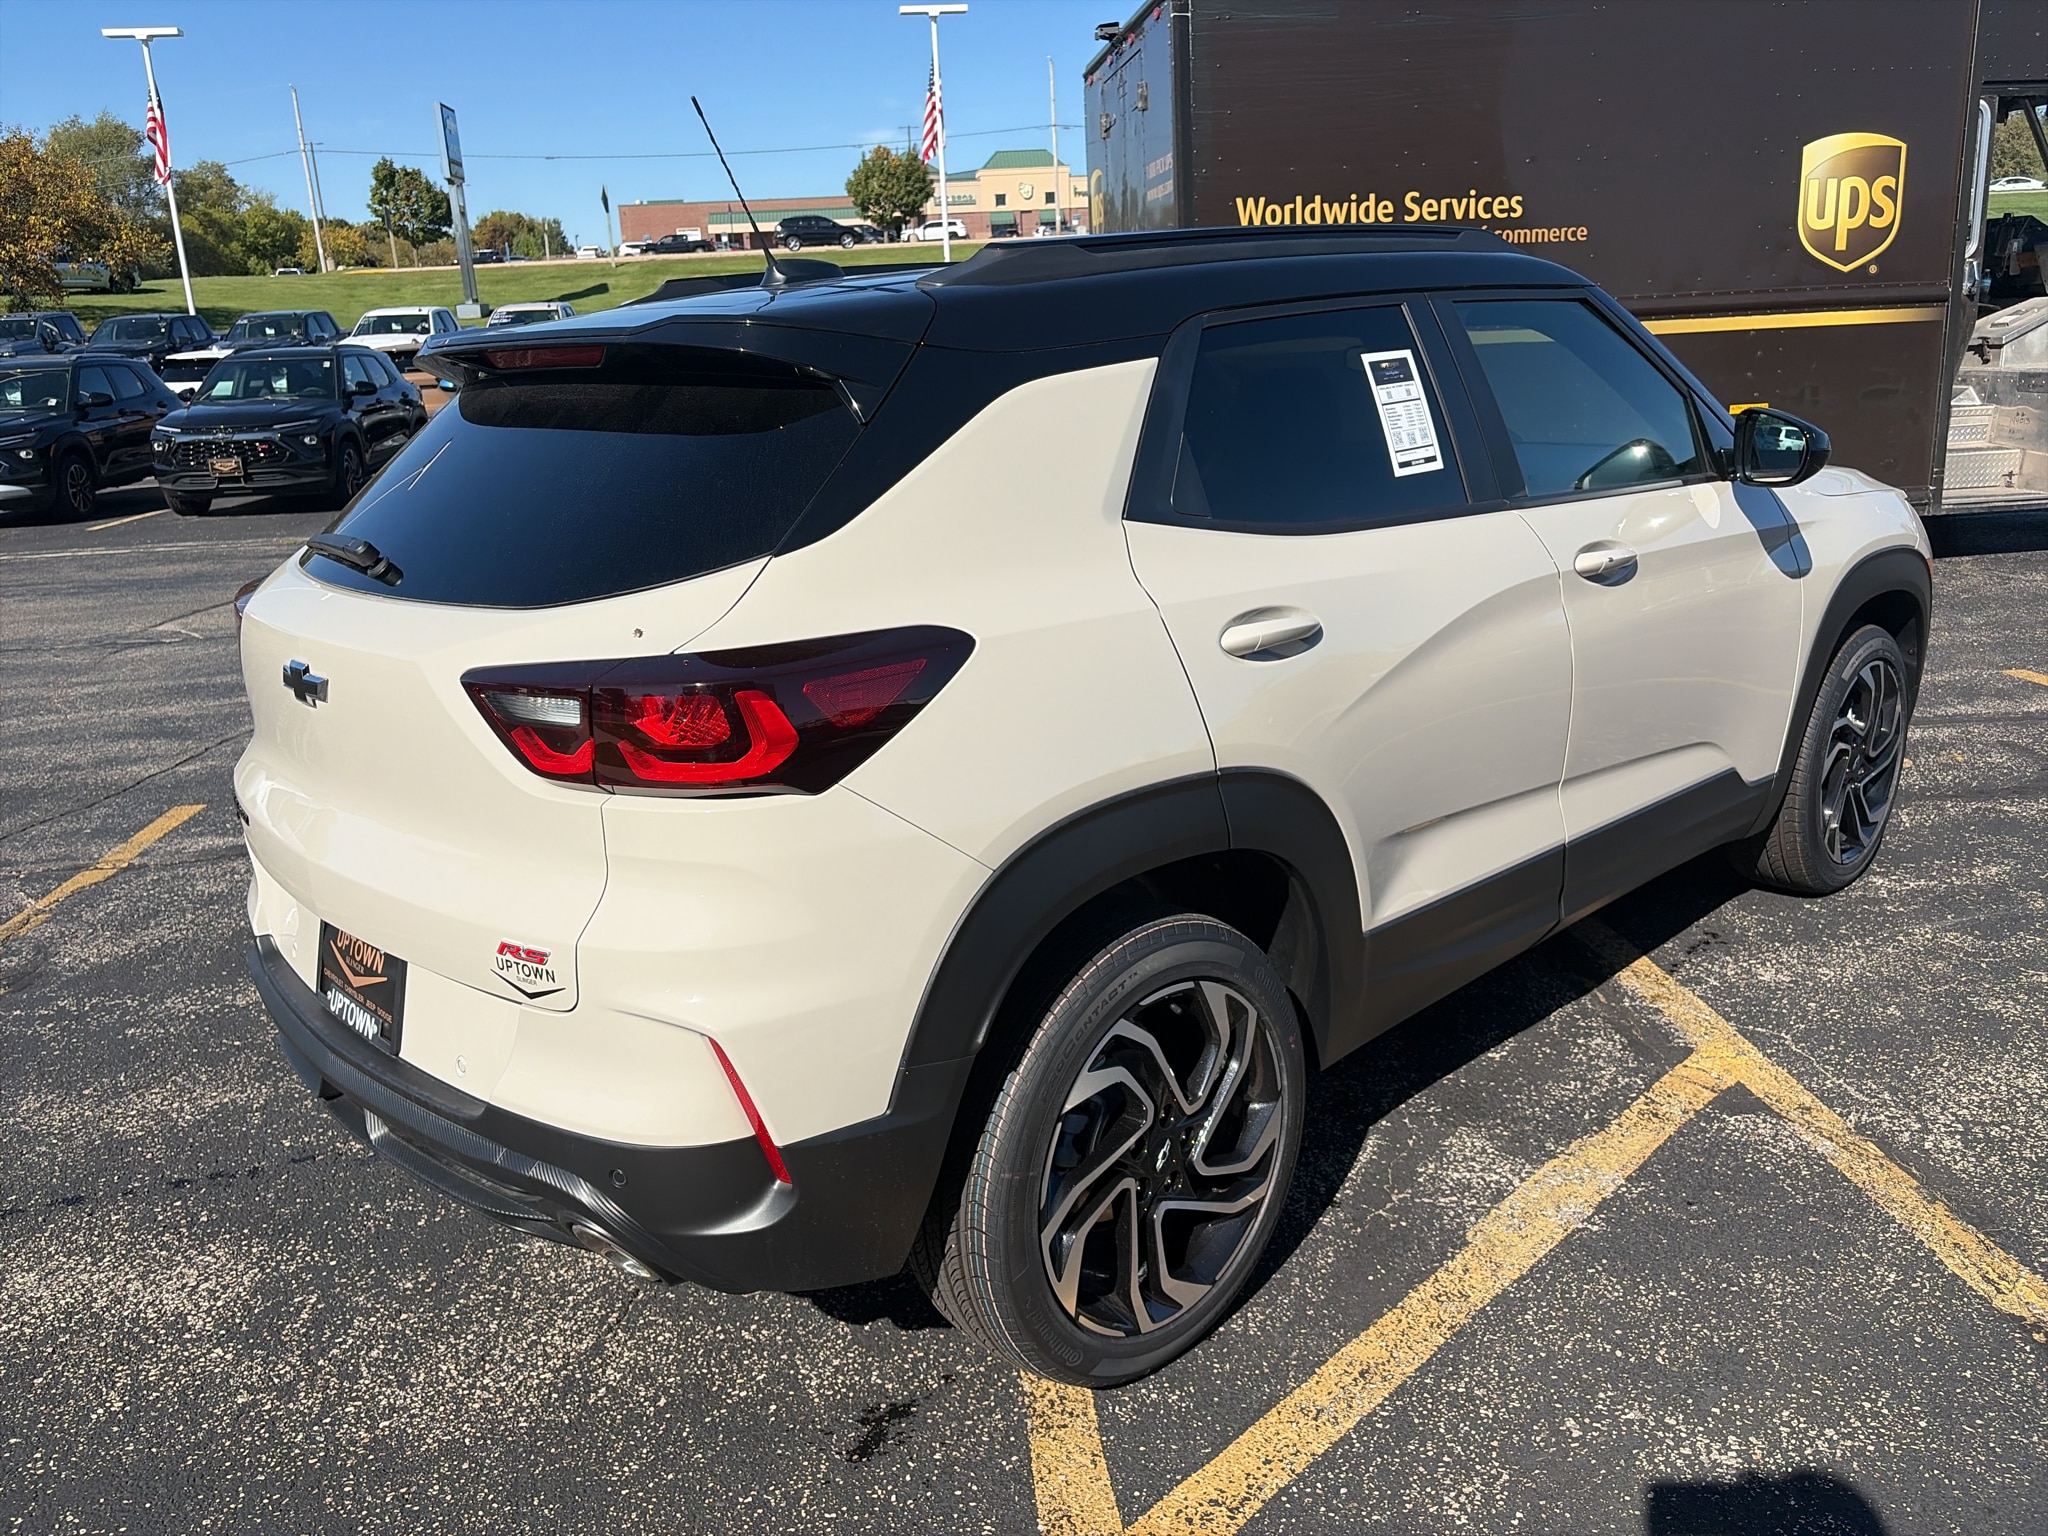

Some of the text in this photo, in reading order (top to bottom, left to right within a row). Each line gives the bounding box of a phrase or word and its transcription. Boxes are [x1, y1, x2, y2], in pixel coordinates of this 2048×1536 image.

[1235, 189, 1523, 226] Worldwide Services
[1806, 175, 1896, 251] ups
[337, 929, 385, 974] UPTOWN
[345, 954, 365, 975] SLINGER
[496, 956, 556, 984] UPTOWN
[497, 941, 551, 966] RS
[330, 987, 375, 1041] UPTOWN
